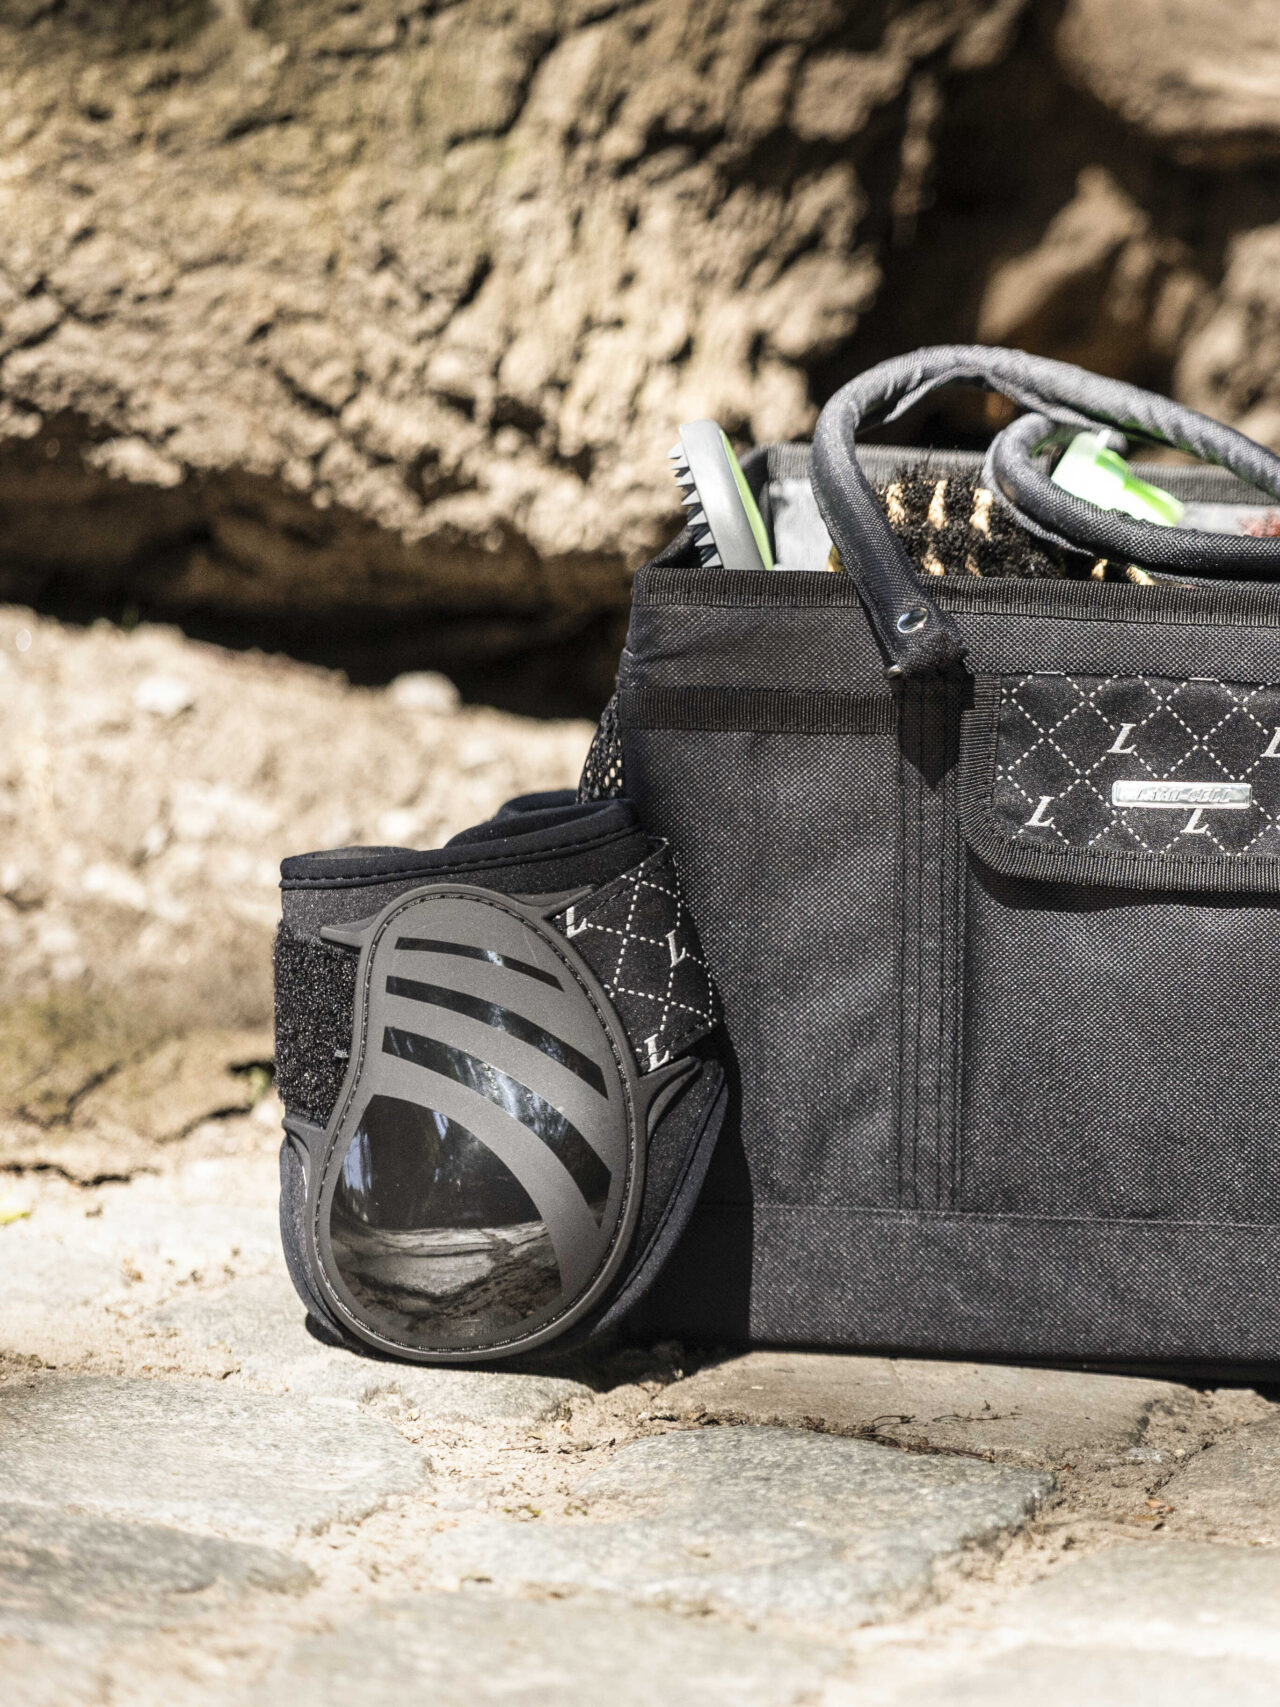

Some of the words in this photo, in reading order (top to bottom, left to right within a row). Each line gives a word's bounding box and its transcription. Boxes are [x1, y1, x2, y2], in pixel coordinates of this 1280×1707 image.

[1107, 722, 1139, 754] L
[1024, 796, 1056, 827] L
[1179, 808, 1210, 835] L
[566, 906, 588, 939] L
[666, 930, 686, 967] L
[645, 1033, 670, 1073] L
